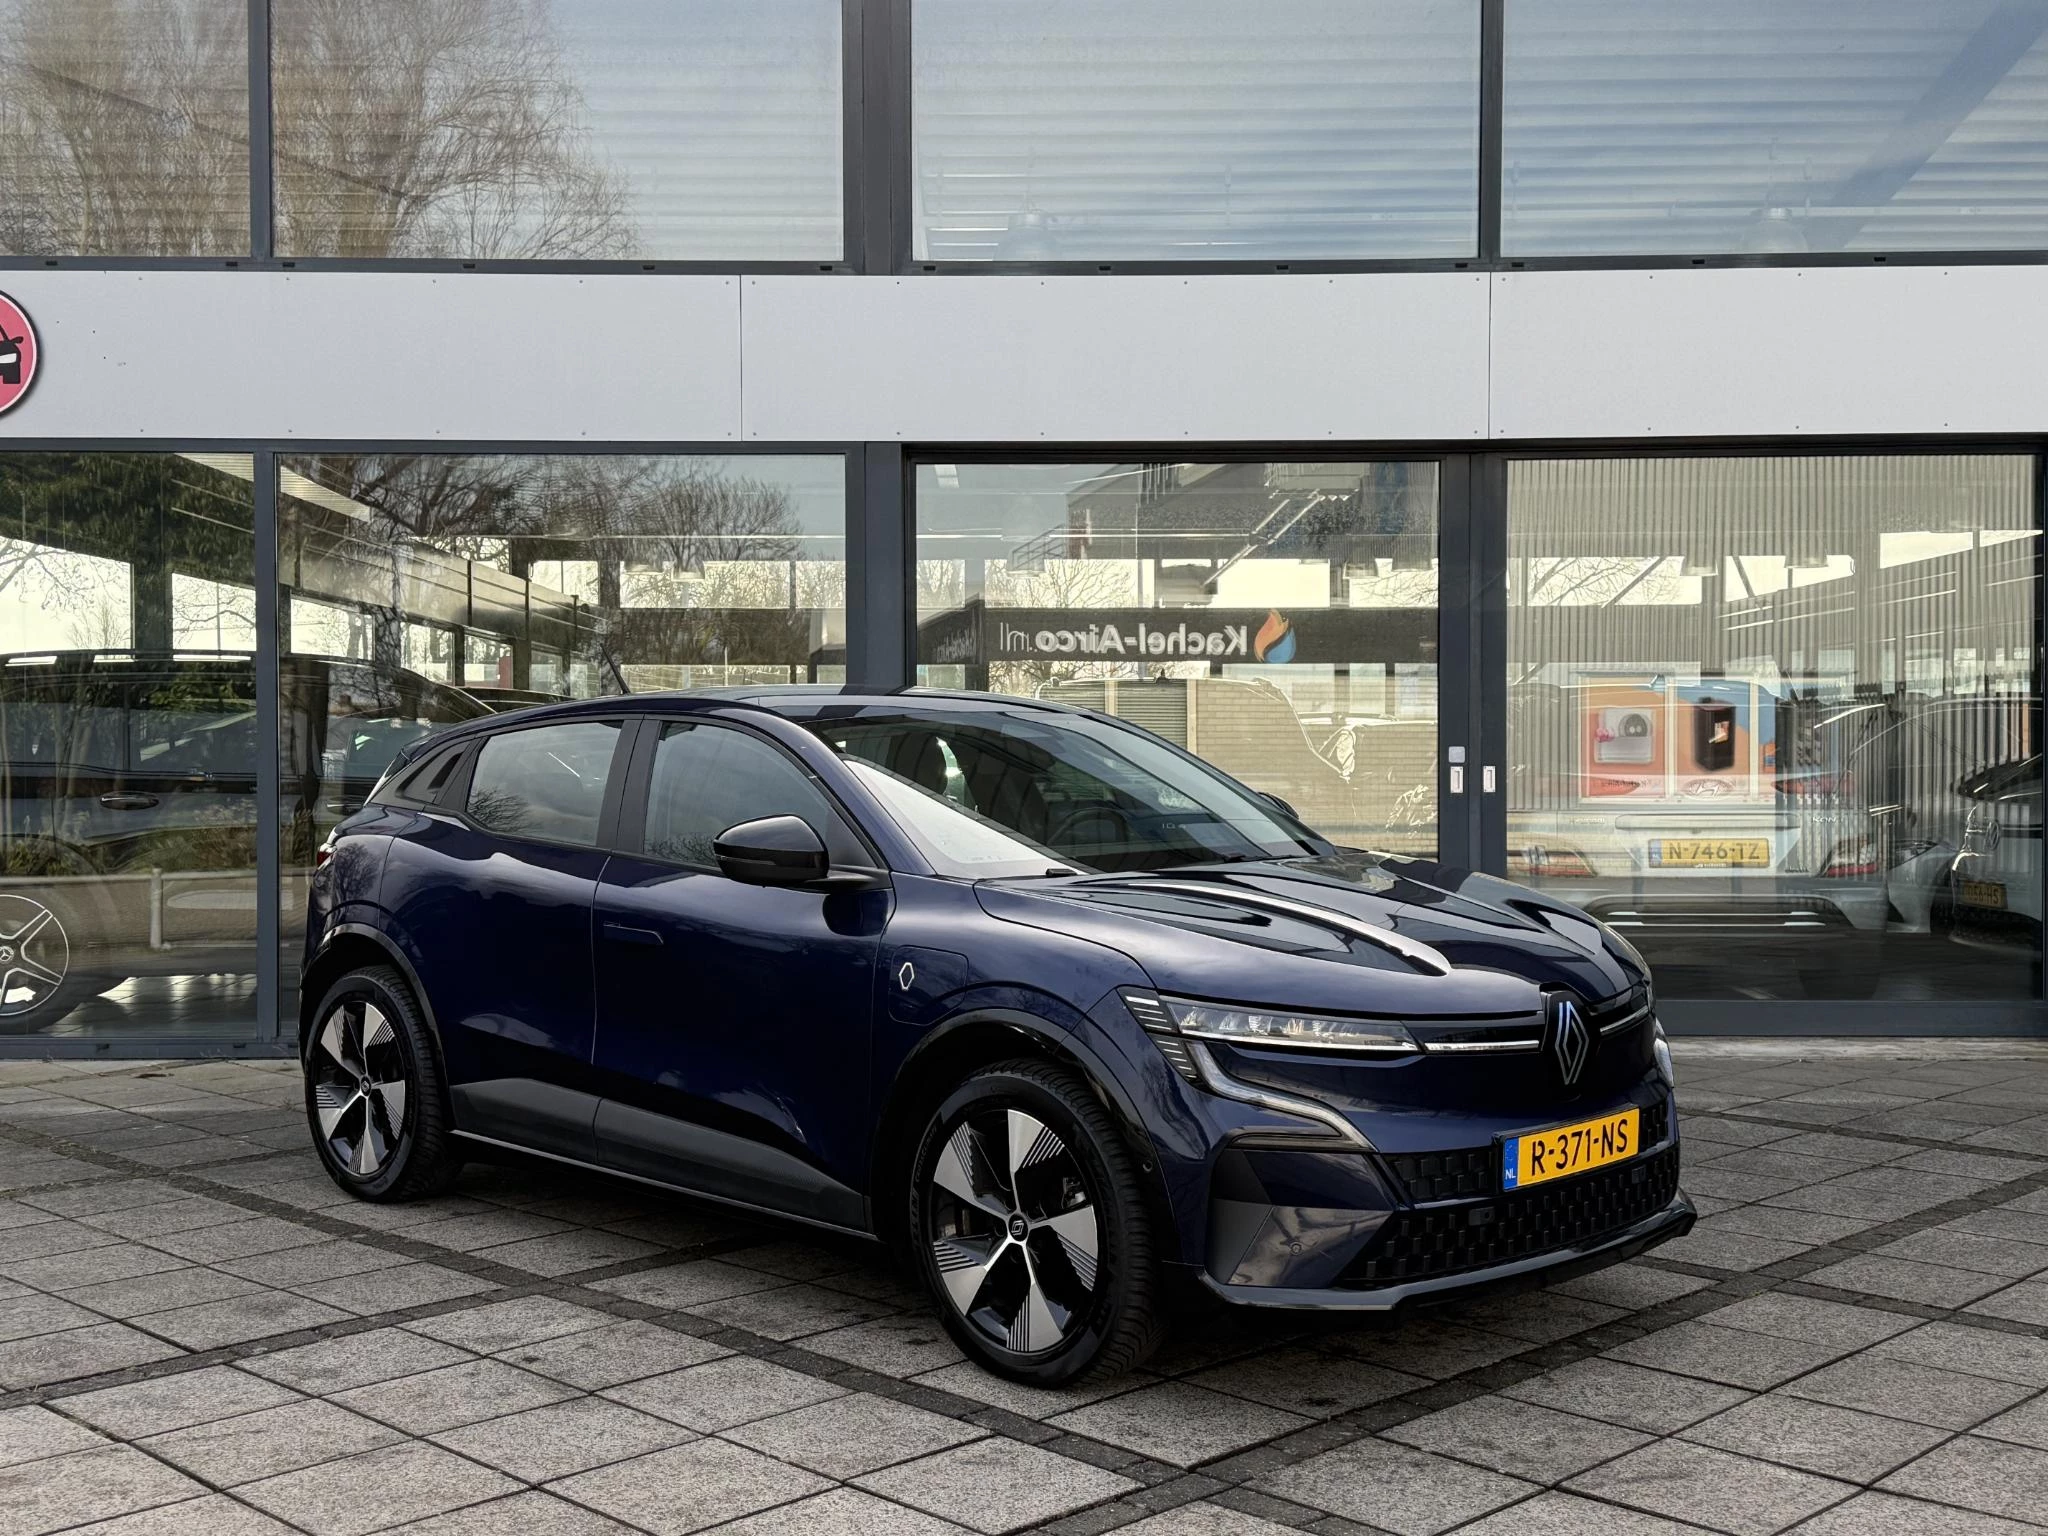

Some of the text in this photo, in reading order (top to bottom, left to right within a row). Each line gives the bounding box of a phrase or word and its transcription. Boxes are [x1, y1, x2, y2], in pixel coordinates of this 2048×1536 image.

[1668, 842, 1760, 860] N-746-TZ
[1505, 1118, 1628, 1180] NL R-371-NS
